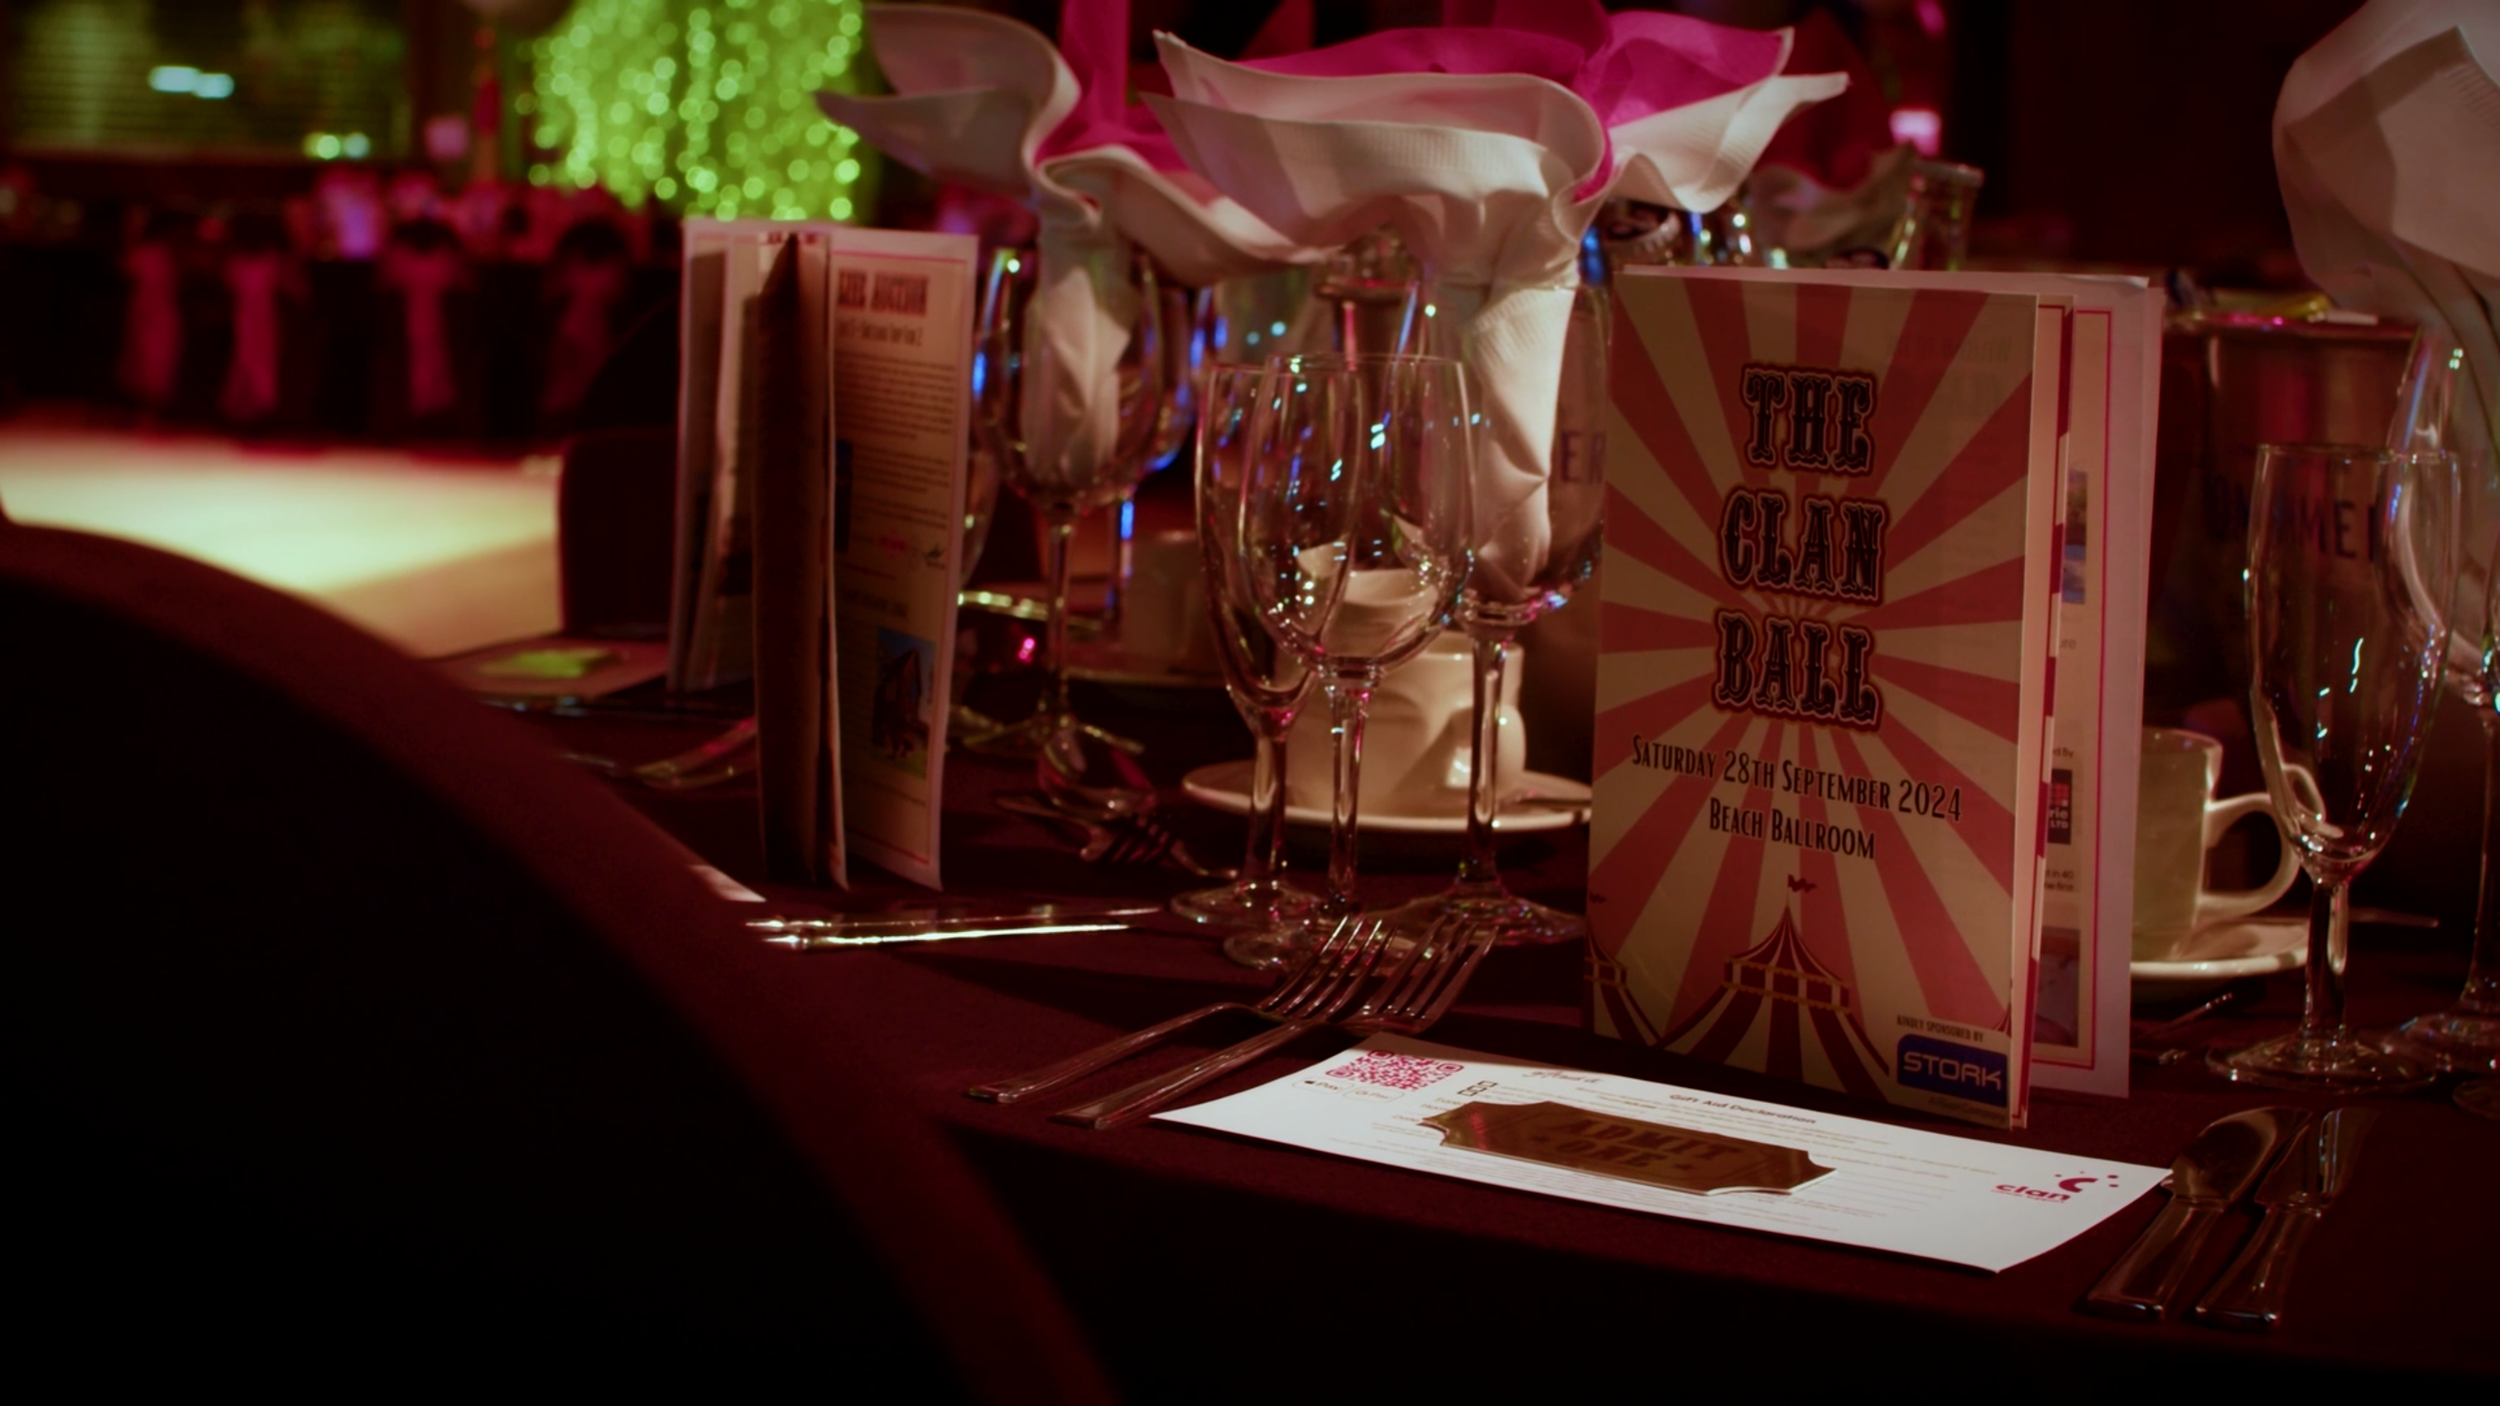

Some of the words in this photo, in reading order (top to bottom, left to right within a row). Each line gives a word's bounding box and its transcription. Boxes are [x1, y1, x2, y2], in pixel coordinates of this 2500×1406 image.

[1744, 364, 1877, 476] THE
[1720, 486, 1888, 602] CLAN
[1714, 608, 1882, 732] BALL
[1631, 735, 1718, 781] SATURDAY
[1723, 751, 1775, 791] 28TH
[1782, 759, 1891, 812] SEPTEMBER
[1898, 780, 1963, 823] 2024
[1708, 797, 1764, 840] BEACH
[1771, 809, 1877, 861] BALLROOM
[1896, 1014, 1925, 1031] KINDLY
[1925, 1020, 1972, 1041] SPONSORED
[1971, 1031, 1985, 1043] BY
[1903, 1051, 2003, 1092] STORK
[1670, 1094, 1699, 1103] Gift
[1703, 1099, 1729, 1109] Aid
[1729, 1104, 1817, 1125] Declaration
[1548, 1118, 1744, 1160] ADMIT
[1556, 1139, 1669, 1168] ONE
[1994, 1184, 2071, 1201] clan
